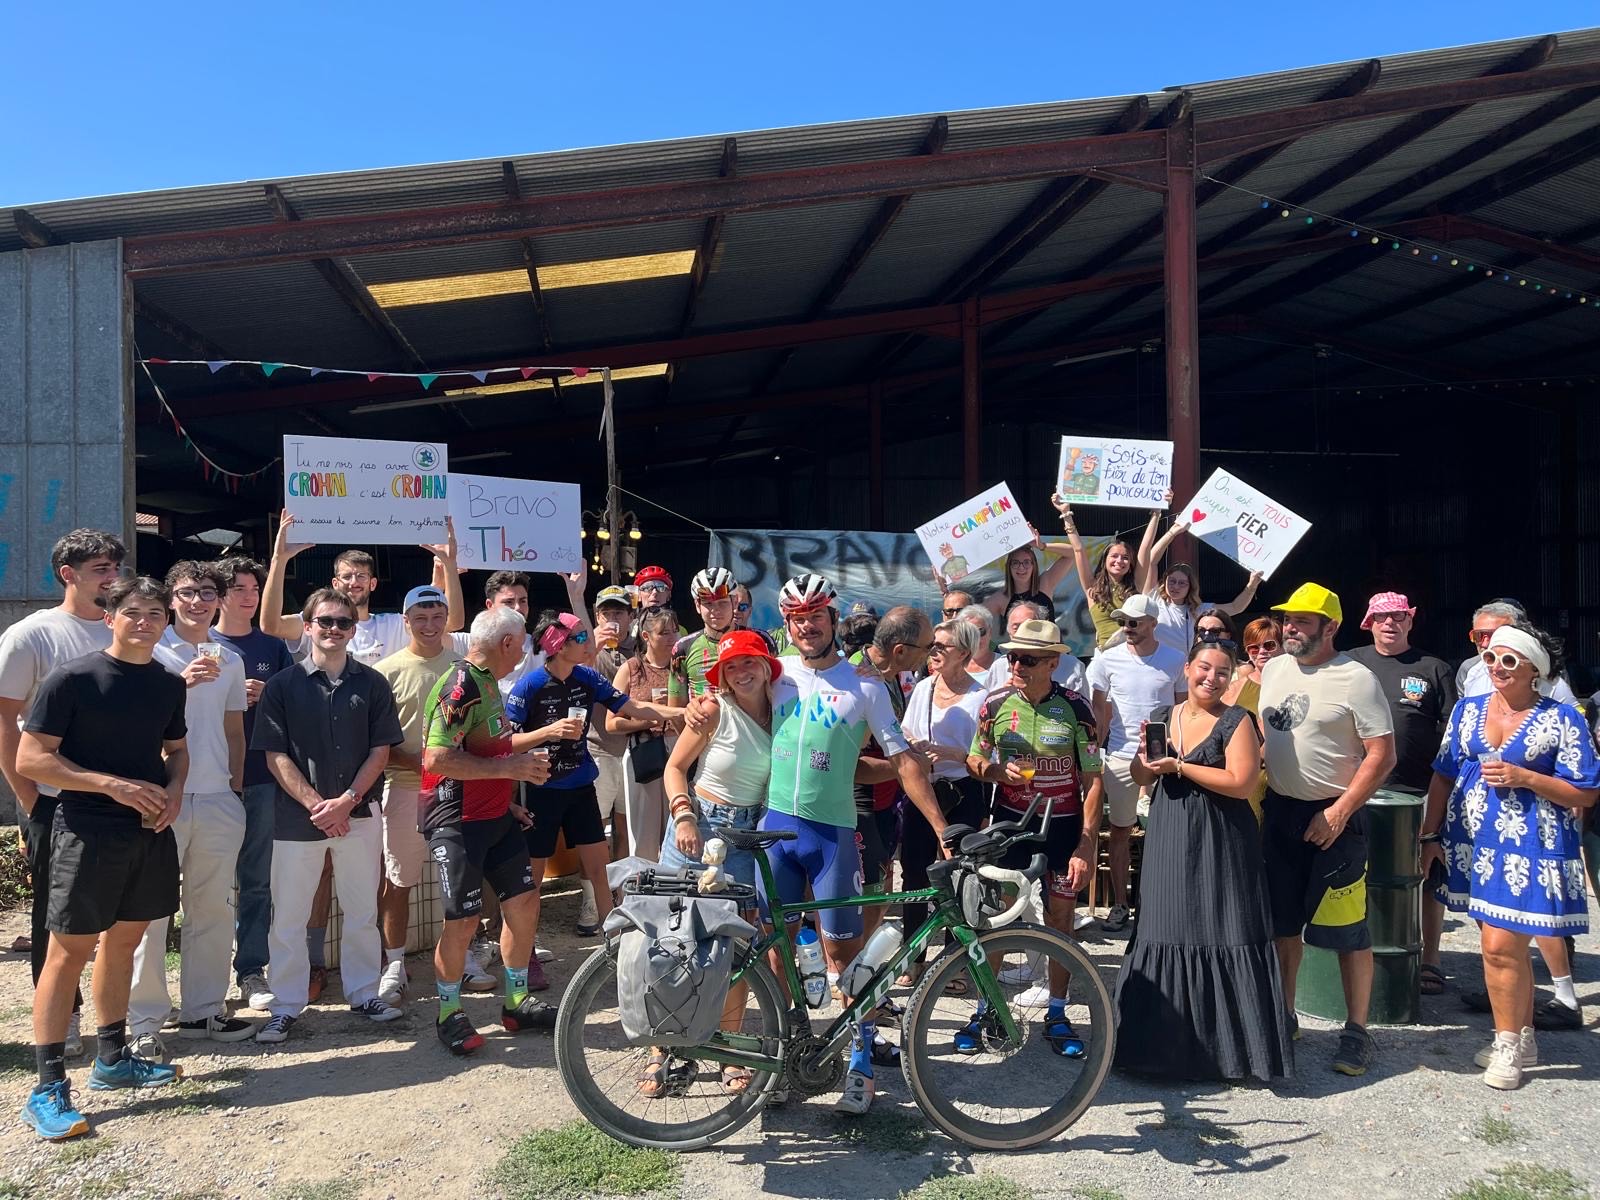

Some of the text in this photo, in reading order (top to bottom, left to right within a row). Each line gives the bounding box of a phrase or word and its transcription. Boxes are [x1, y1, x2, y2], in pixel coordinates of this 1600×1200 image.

[290, 442, 312, 468] Tu
[359, 462, 377, 473] pas
[384, 463, 409, 471] avec
[1108, 444, 1147, 466] Sois
[288, 471, 348, 498] CROHN
[391, 473, 447, 499] CROHN
[1132, 467, 1146, 485] de
[1149, 467, 1169, 487] ton
[468, 484, 557, 519] Bravo
[1106, 484, 1164, 502] parcours
[1214, 475, 1231, 497] On
[1261, 503, 1293, 529] TOUS
[336, 514, 346, 525] de
[388, 514, 403, 526] ton
[921, 522, 950, 541] Notre
[468, 525, 538, 562] Théo
